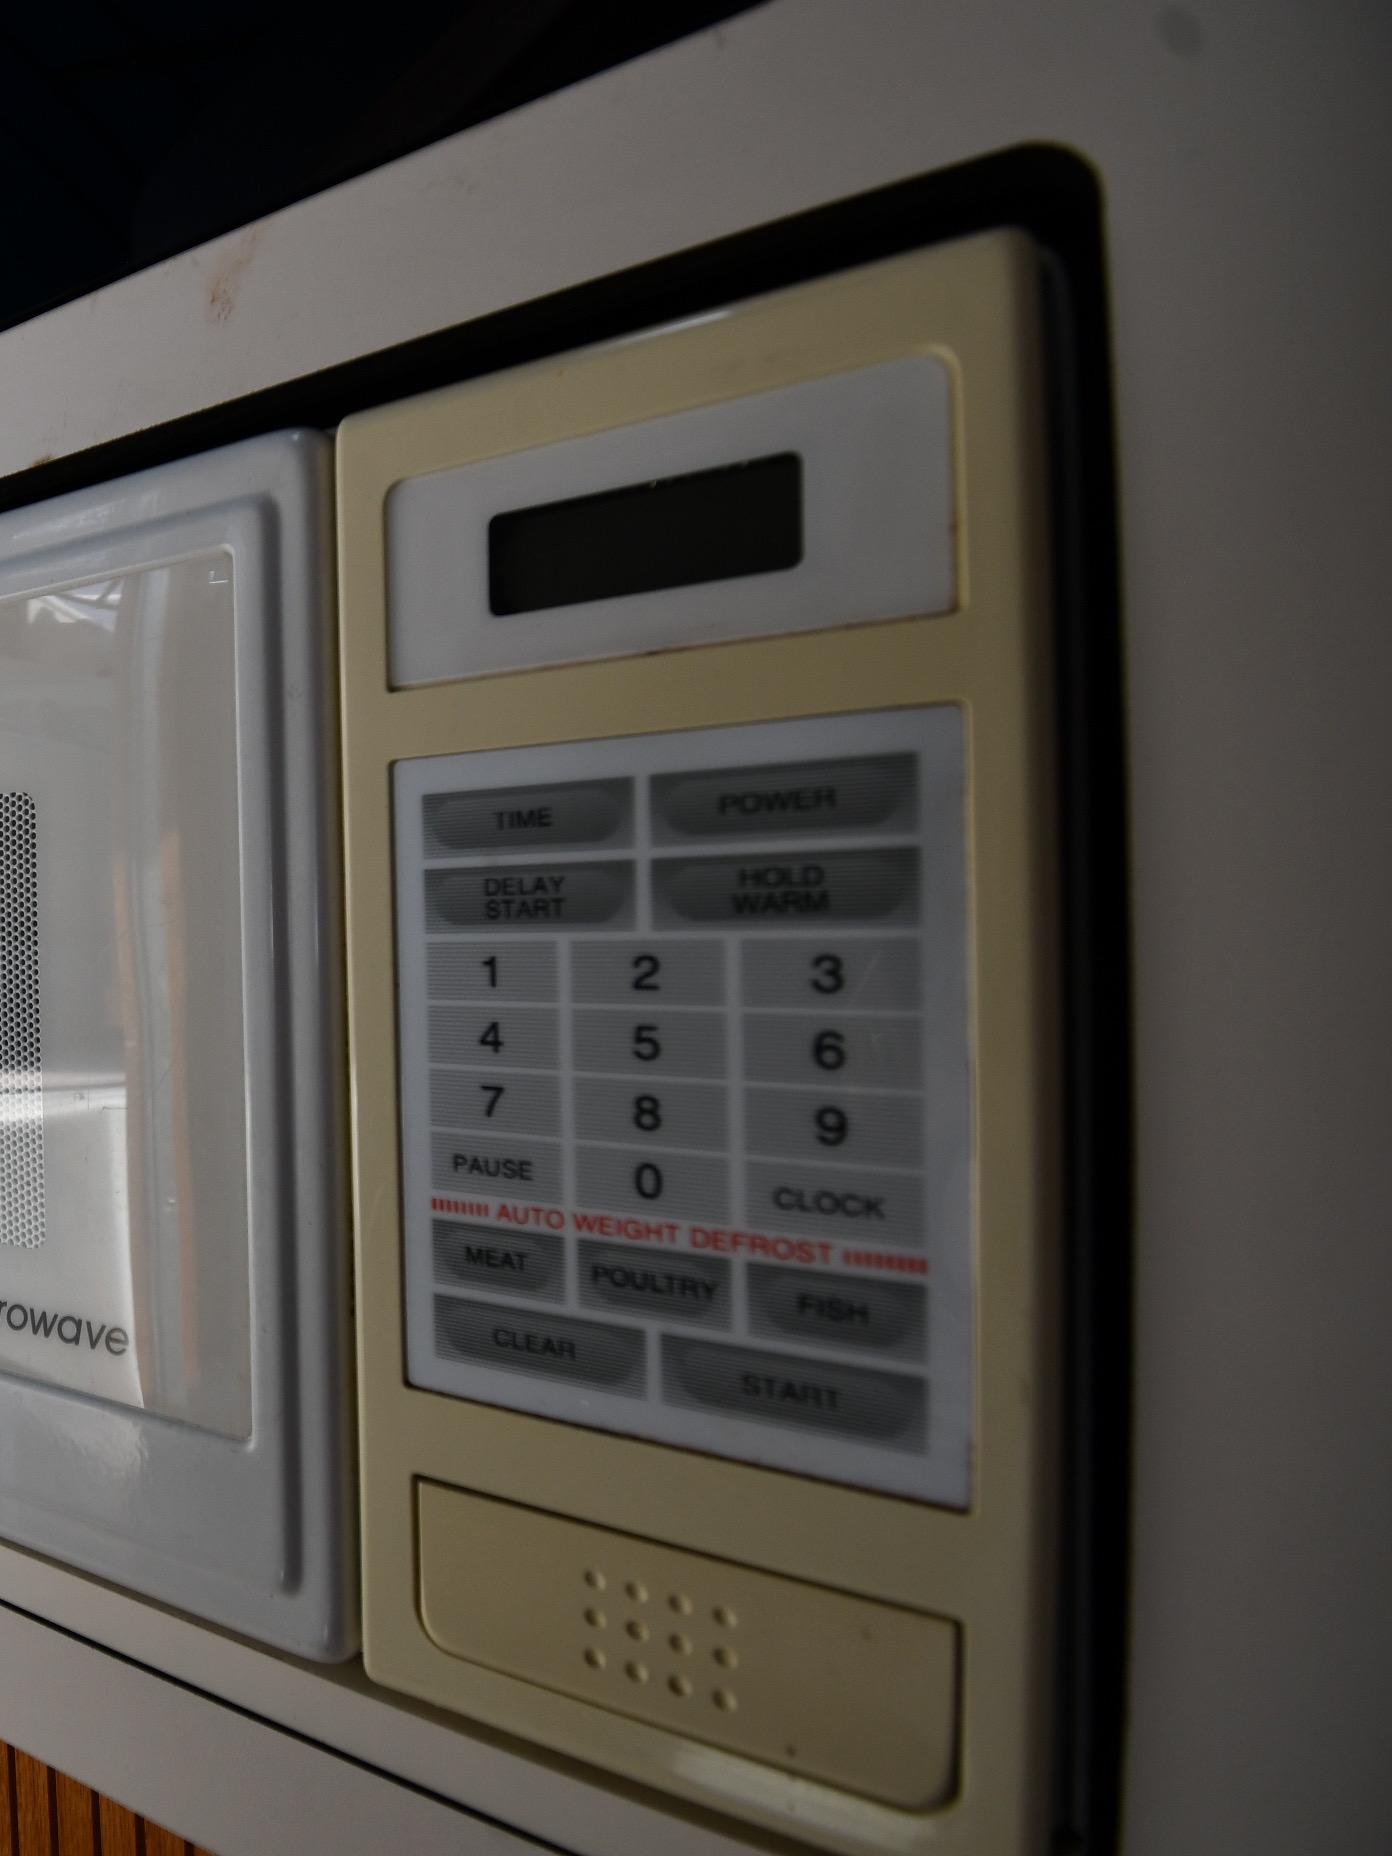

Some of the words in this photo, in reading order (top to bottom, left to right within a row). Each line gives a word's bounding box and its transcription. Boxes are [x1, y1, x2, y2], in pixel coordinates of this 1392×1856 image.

[718, 786, 836, 817] POWER
[495, 807, 553, 831] TIME
[483, 876, 565, 899] DELAY
[738, 865, 825, 890] HOLD
[484, 898, 564, 920] START
[731, 890, 829, 916] WARM
[482, 956, 498, 988] 1
[631, 954, 660, 991] 2
[811, 953, 844, 994] 3
[479, 1022, 504, 1053] 4
[632, 1025, 660, 1061] 5
[814, 1031, 845, 1071] 6
[479, 1085, 504, 1118] 7
[633, 1096, 662, 1132] 8
[815, 1107, 848, 1147] 9
[452, 1154, 533, 1181] PAUSE
[634, 1163, 662, 1200] 0
[773, 1187, 885, 1220] CLOCK
[496, 1204, 565, 1230] AUTO
[573, 1213, 680, 1244] WEIGHT
[690, 1228, 834, 1265] DEFROST
[464, 1246, 529, 1271] MEAT
[591, 1265, 720, 1300] POULTRY
[798, 1295, 869, 1324] FISH
[493, 1329, 576, 1359] CLEAR
[741, 1375, 839, 1409] START
